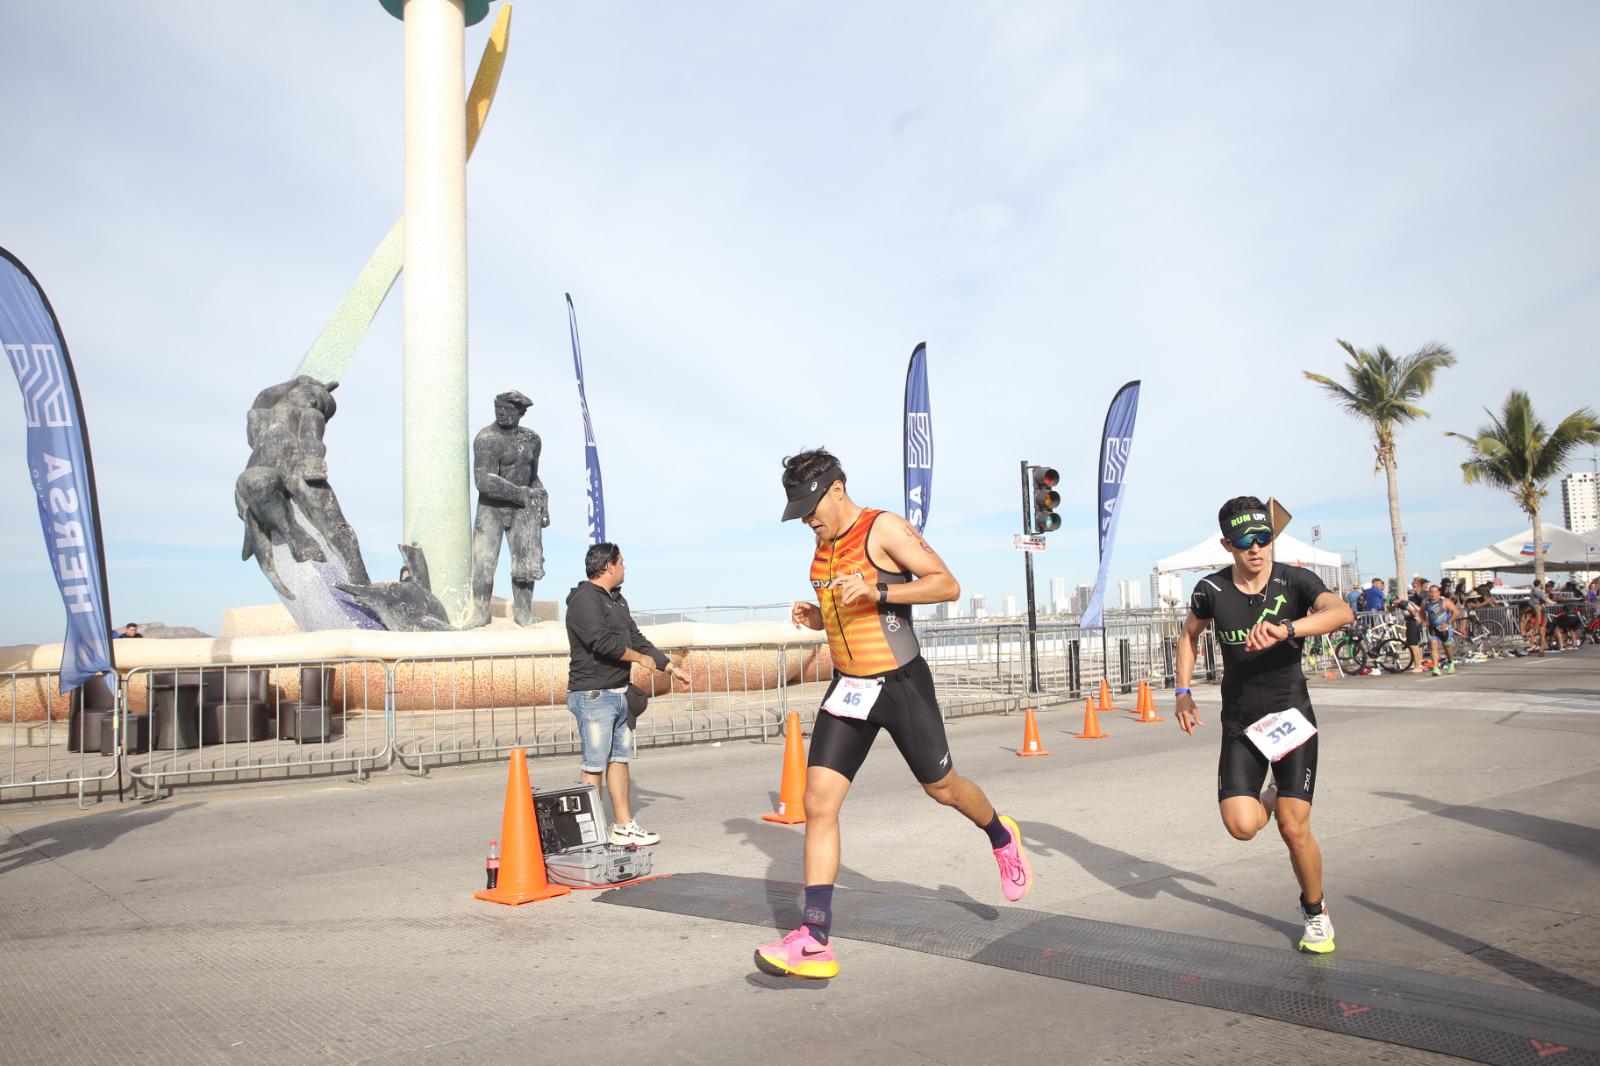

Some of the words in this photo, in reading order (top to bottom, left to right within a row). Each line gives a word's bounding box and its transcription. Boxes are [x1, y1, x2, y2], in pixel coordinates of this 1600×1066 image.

[1230, 513, 1251, 527] RUN
[842, 691, 862, 706] 46
[1266, 721, 1297, 745] 312
[1303, 767, 1312, 793] 2XU
